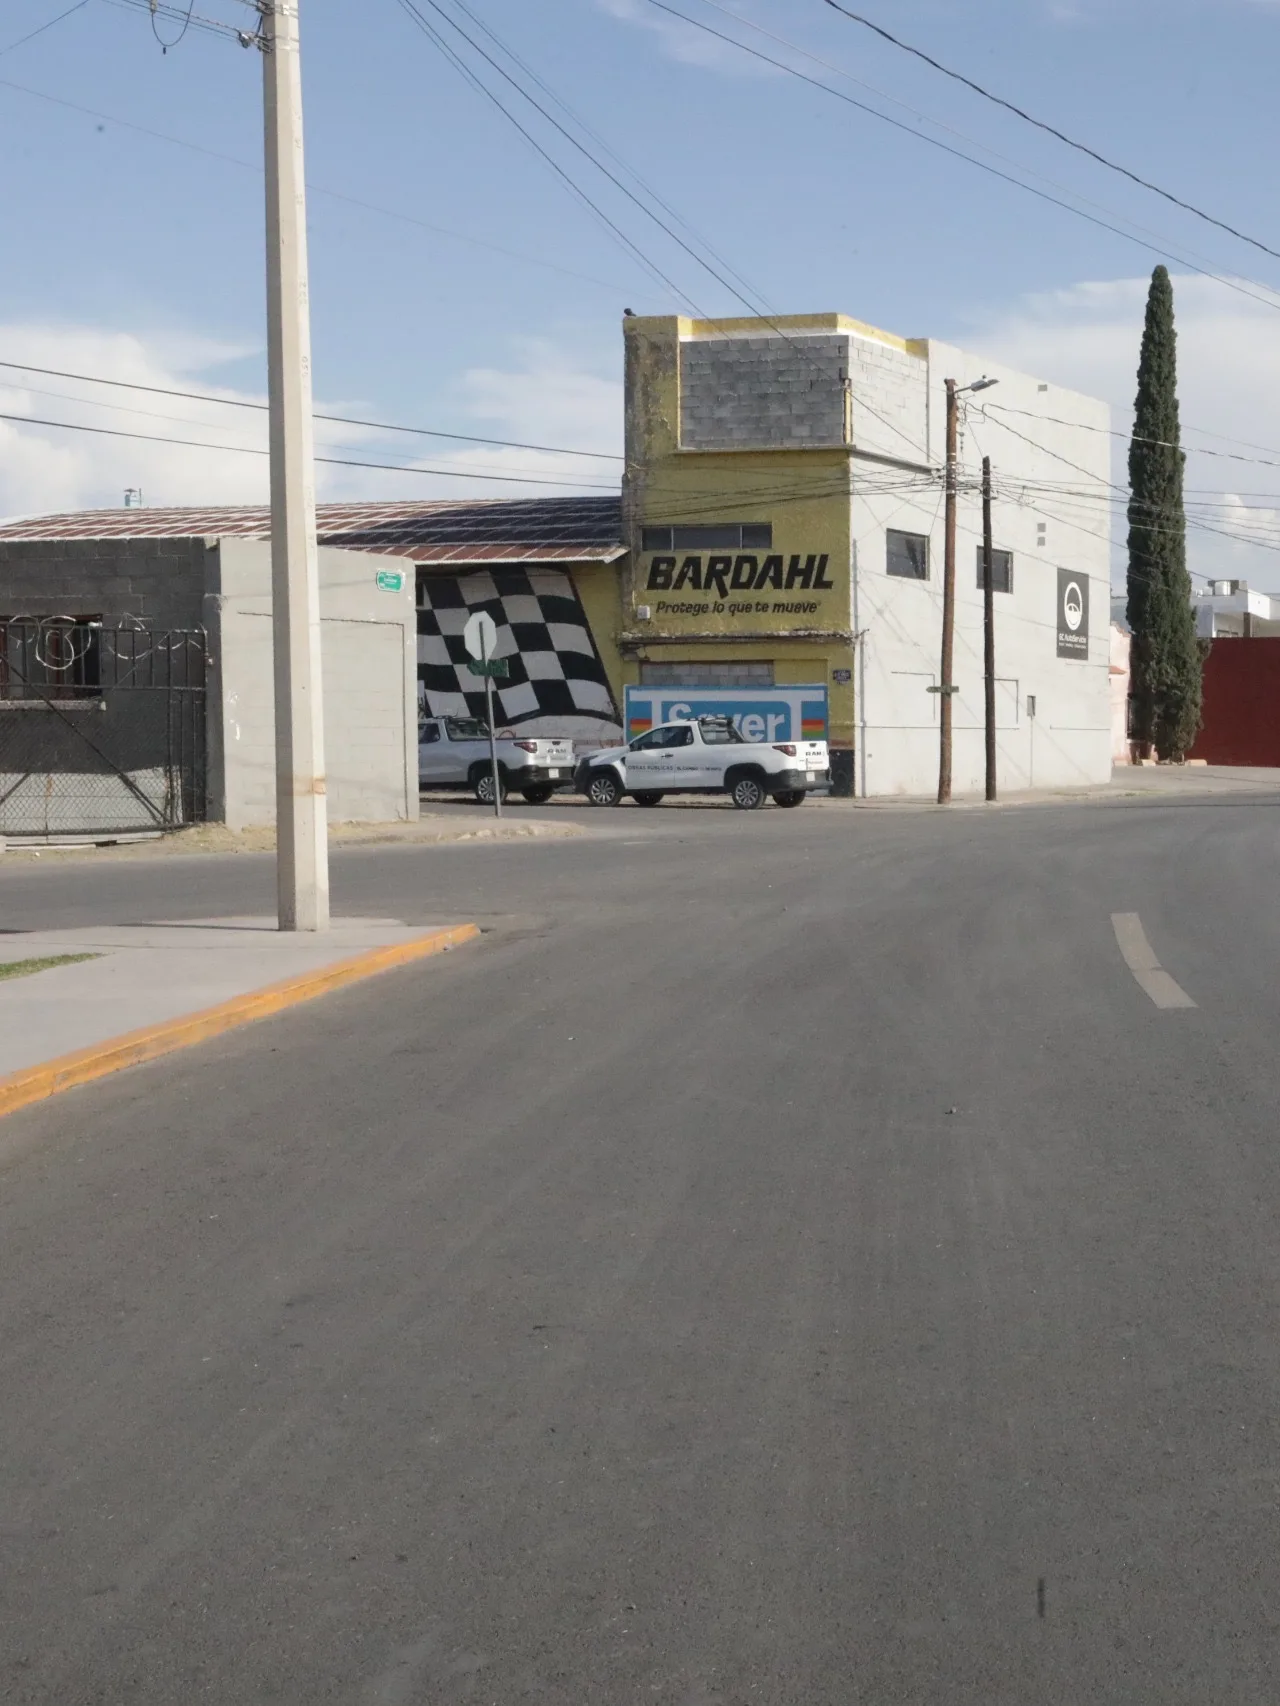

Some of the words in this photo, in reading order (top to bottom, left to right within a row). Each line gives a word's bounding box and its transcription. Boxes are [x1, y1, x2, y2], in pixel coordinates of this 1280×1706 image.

[647, 554, 834, 599] BARDAHL
[656, 601, 709, 616] Protege
[712, 601, 724, 613] lo
[728, 602, 750, 616] que
[755, 601, 769, 613] te
[772, 602, 817, 614] mueve
[668, 703, 785, 743] Ser
